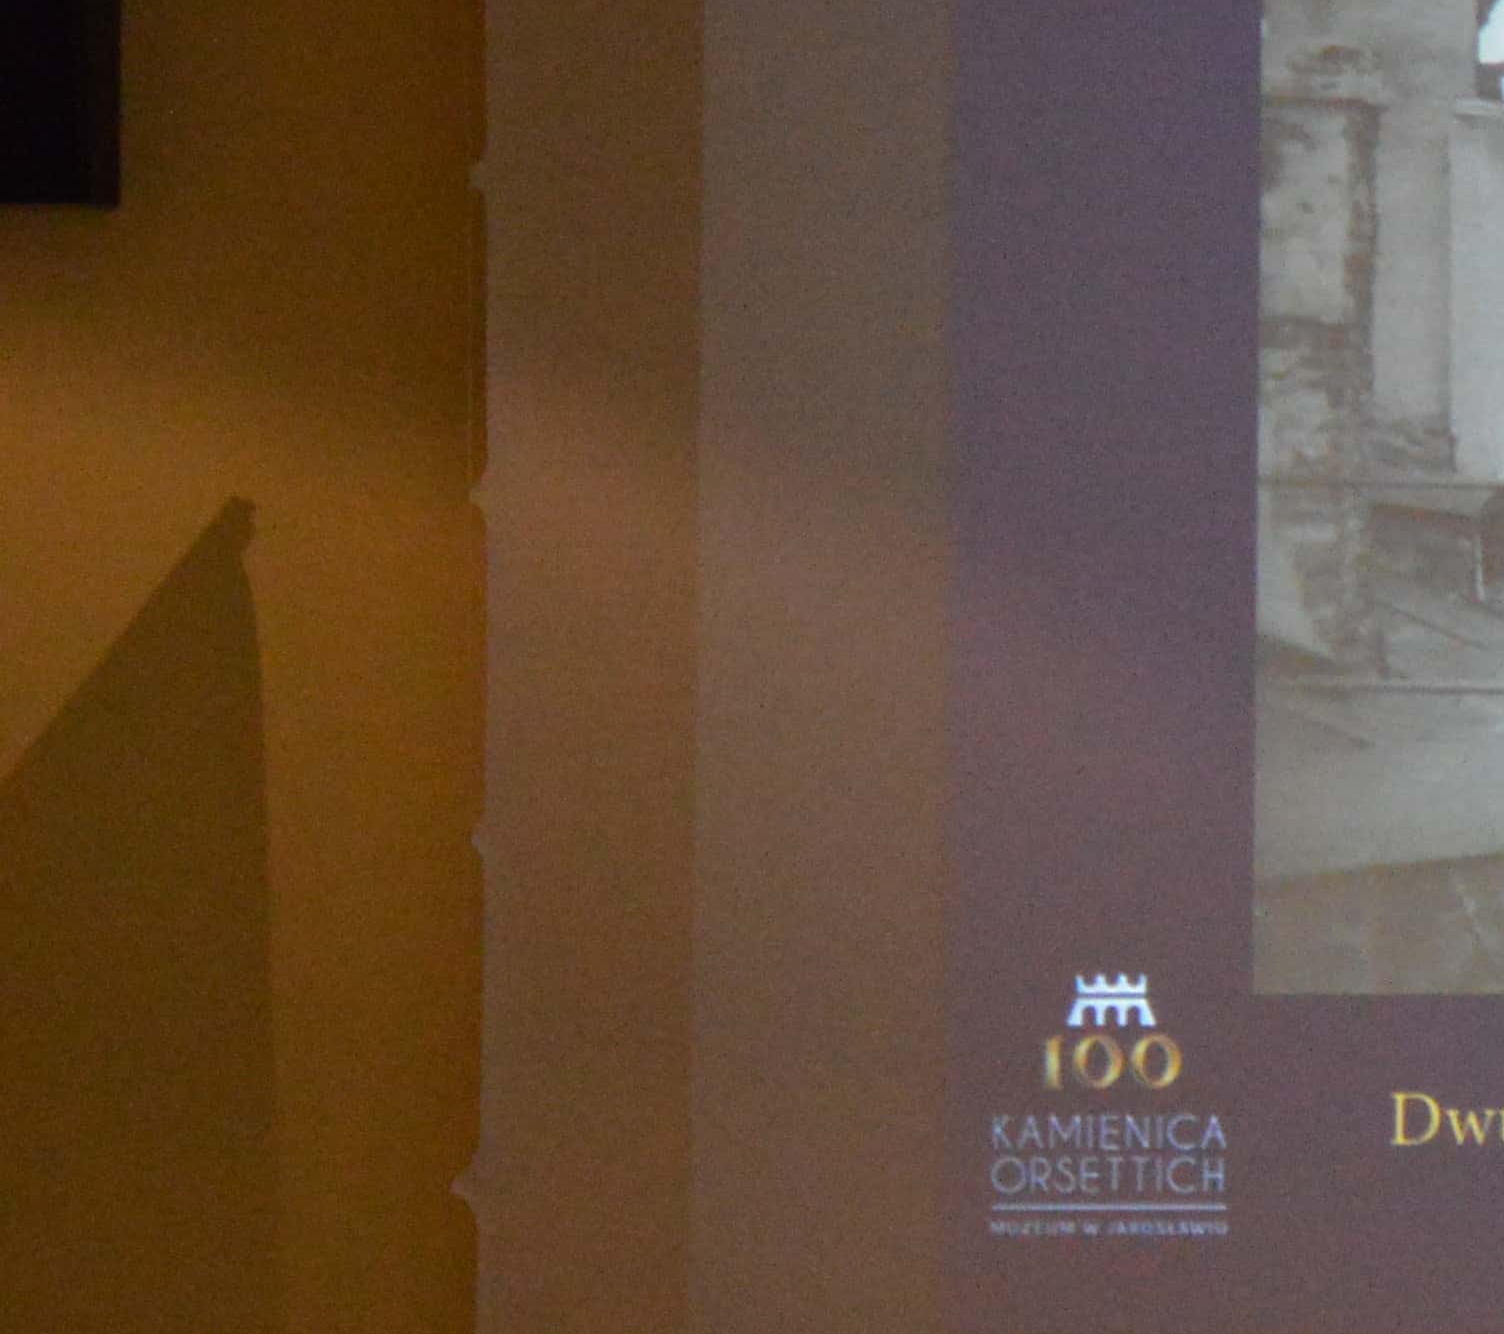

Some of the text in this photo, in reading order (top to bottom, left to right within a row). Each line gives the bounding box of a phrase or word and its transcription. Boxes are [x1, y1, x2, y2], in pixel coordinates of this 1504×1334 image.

[1043, 1034, 1183, 1090] 100
[990, 1113, 1228, 1152] KAMIENICA
[990, 1155, 1227, 1195] ORSETTICH
